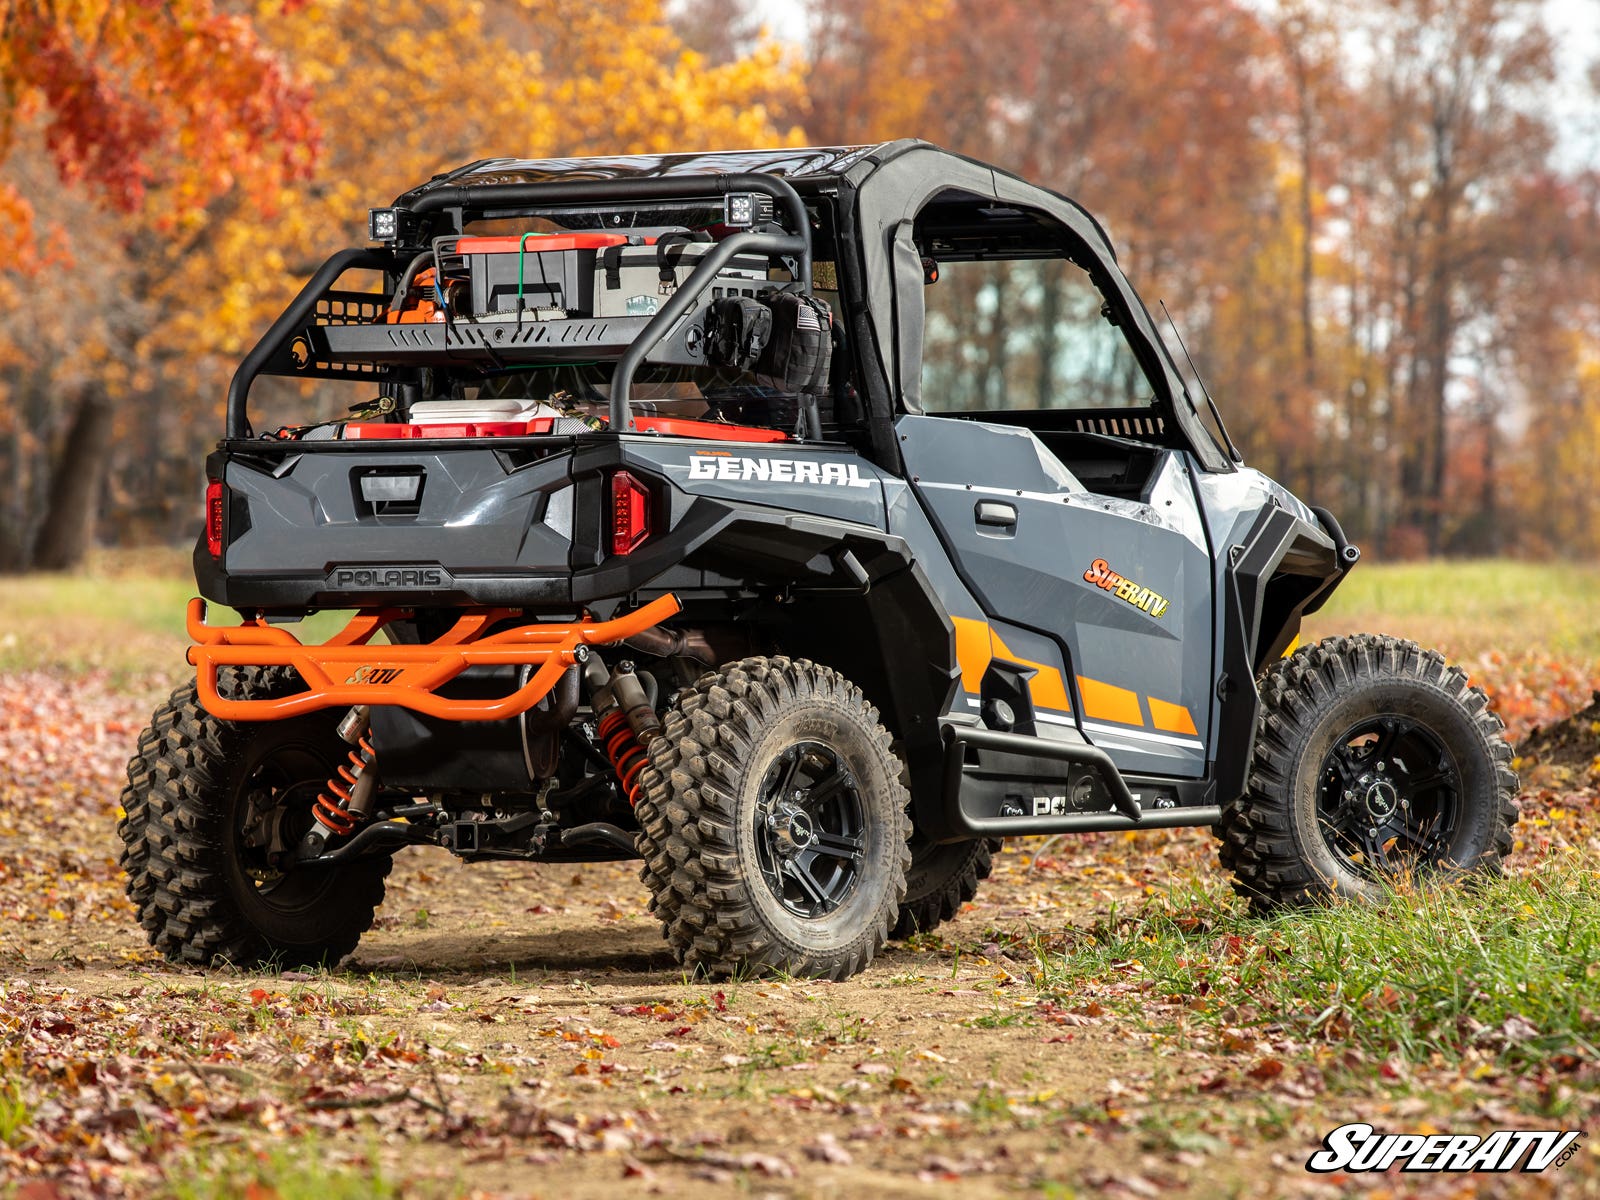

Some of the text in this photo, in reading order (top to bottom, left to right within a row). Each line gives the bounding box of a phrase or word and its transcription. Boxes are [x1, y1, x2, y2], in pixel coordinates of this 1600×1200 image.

[688, 455, 871, 488] GENERAL
[337, 570, 441, 587] POLARIS
[1083, 558, 1168, 618] SUPERATV
